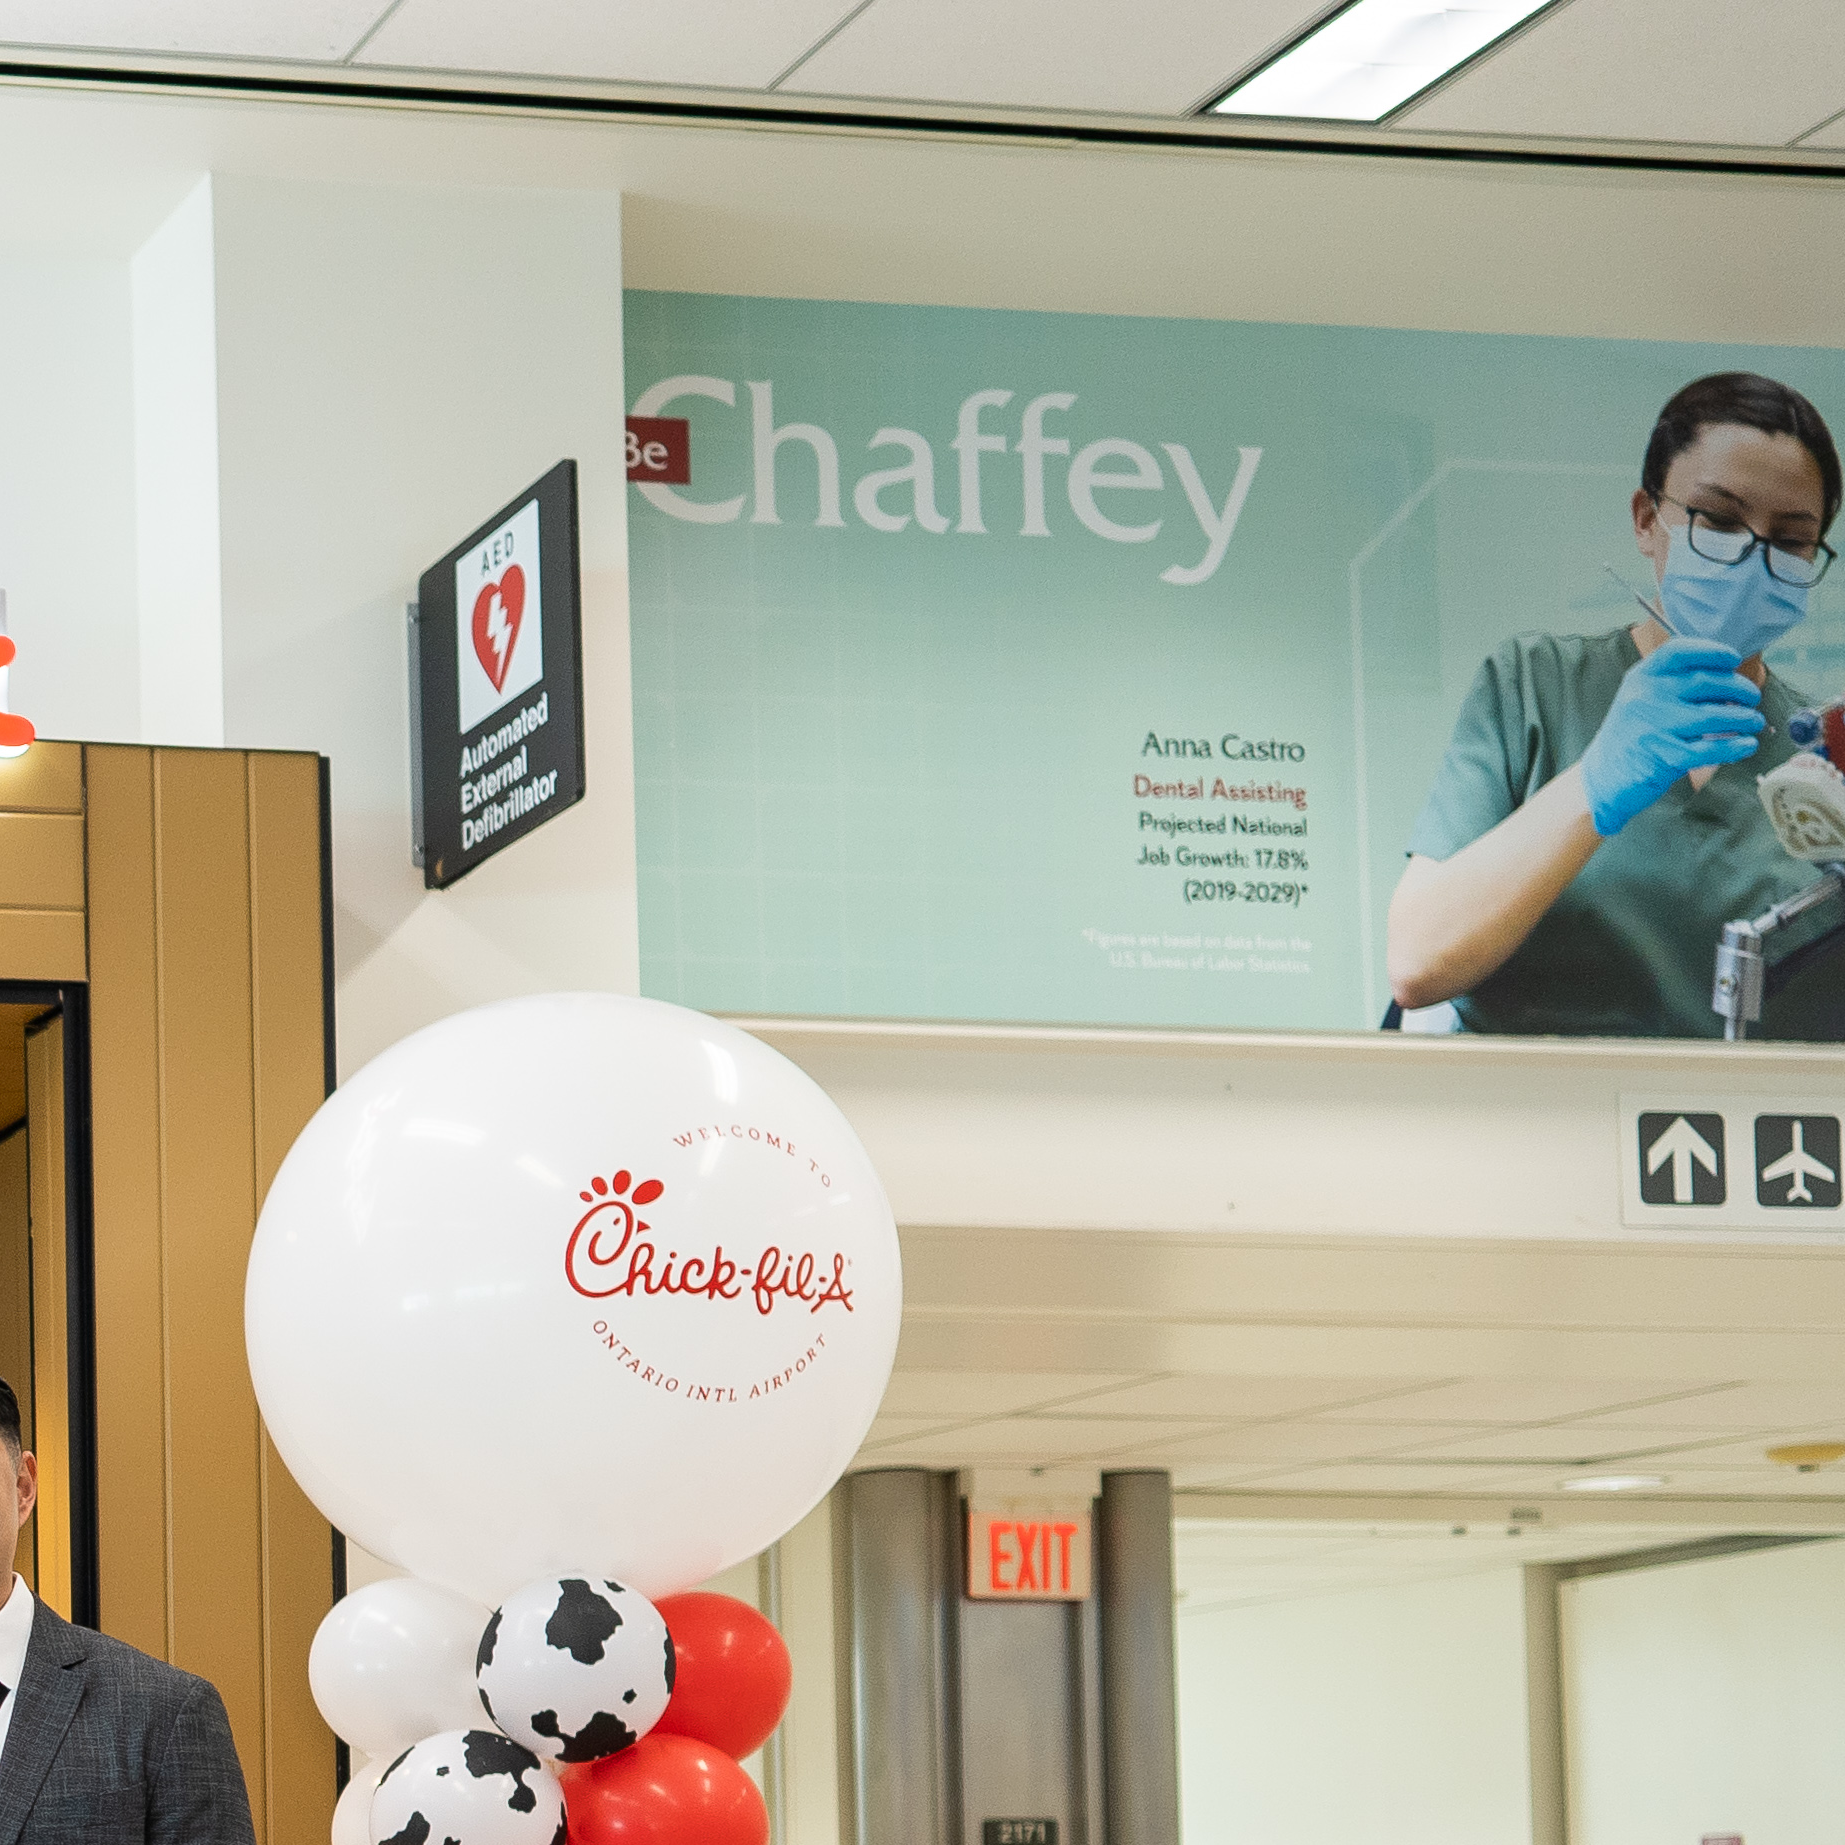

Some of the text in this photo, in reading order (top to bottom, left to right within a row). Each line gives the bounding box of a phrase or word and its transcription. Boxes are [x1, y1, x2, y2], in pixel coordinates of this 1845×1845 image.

[629, 372, 1265, 587] Chaffey
[480, 531, 515, 577] AED
[460, 691, 550, 780] Automated
[1141, 730, 1306, 763] Anna Castro
[460, 744, 528, 816] External
[461, 768, 559, 851] Defibrillator
[1134, 772, 1308, 811] Dental Assisting
[1137, 844, 1309, 871] Job Growth: 17.8%
[1138, 810, 1309, 839] Projected National
[672, 1124, 831, 1188] WELCOME TO
[593, 1319, 827, 1403] ONTARIO INTL AIRPORT
[988, 1520, 1079, 1593] EXIT
